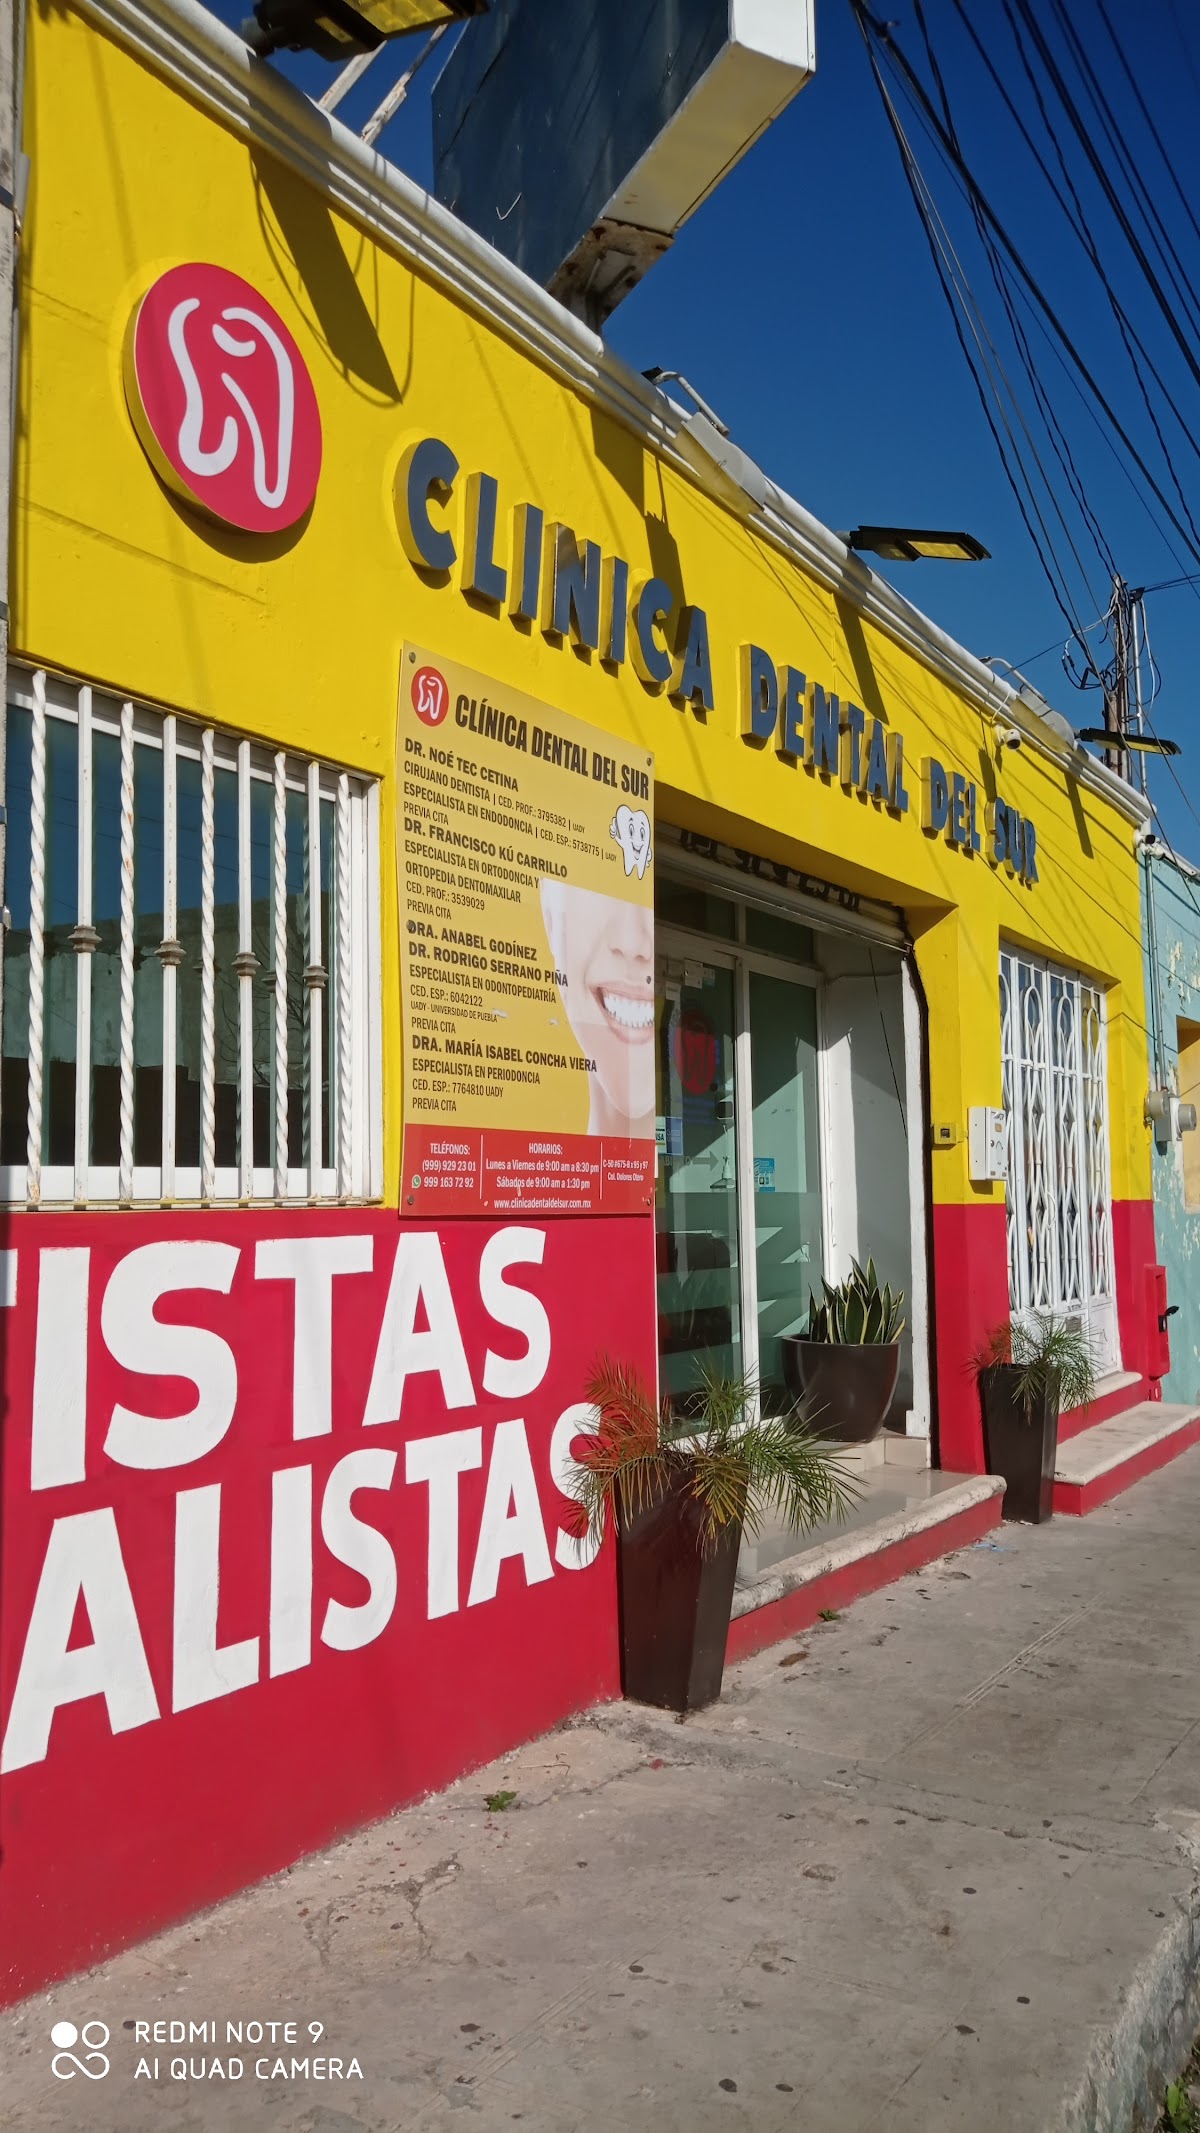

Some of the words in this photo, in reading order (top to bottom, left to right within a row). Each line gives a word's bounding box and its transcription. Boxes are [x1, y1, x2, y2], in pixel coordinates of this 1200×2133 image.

[404, 437, 715, 712] CLINICA
[746, 643, 909, 813] DENTAL
[926, 757, 980, 853] DEL
[989, 797, 1039, 884] SUR
[455, 694, 528, 753] CLÍNICA
[531, 726, 589, 778] DENTAL
[592, 751, 618, 788] DEL
[621, 764, 649, 801] SUR
[404, 737, 426, 758] DR.
[429, 746, 454, 769] NOÉ
[457, 757, 477, 777] TEC
[480, 766, 519, 792] CETINA
[404, 760, 449, 787] CIRUJANO
[450, 776, 491, 802] DENTISTA
[498, 795, 515, 811] CED.
[537, 808, 567, 828] 3795382
[572, 822, 586, 834] UADY
[403, 801, 431, 820] PREVIA
[432, 809, 449, 826] CITA
[404, 781, 466, 814] ESPECIALISTA
[467, 803, 479, 818] EN
[480, 807, 534, 836] ENDODONCIA
[540, 828, 555, 842] CED.
[572, 839, 600, 857] 5738775
[604, 852, 617, 862] UADY
[404, 816, 426, 836] DR.
[429, 824, 497, 857] FRANCISCO
[499, 846, 514, 863] KÚ
[516, 851, 568, 878] CARRILLO
[405, 839, 467, 869] ESPECIALISTA
[468, 858, 480, 873] EN
[481, 861, 534, 887] ORTODONCIA
[532, 877, 540, 889] Y
[405, 860, 456, 887] ORTOPEDIA
[457, 874, 521, 903] DENTOMAXILAR
[406, 880, 425, 896] CED.
[426, 885, 450, 902] PROF.:
[451, 892, 485, 911] 3539029
[407, 898, 434, 916] PREVIA
[435, 905, 452, 920] CITA
[441, 927, 487, 951] ANABEL
[489, 939, 538, 961] GODÍNEZ
[408, 941, 431, 959] DR.
[433, 946, 488, 971] RODRIGO
[490, 958, 542, 982] SERRANO
[544, 969, 569, 987] PIÑA
[409, 964, 471, 988] ESPECIALISTA
[472, 976, 483, 990] EN
[485, 978, 557, 1004] ODONTOPEDIATRÍA
[410, 984, 429, 998] CED.
[430, 987, 449, 1002] ESP.:
[450, 989, 483, 1007] 6042122
[410, 1000, 427, 1011] UADY
[430, 1003, 469, 1018] UNIVERSIDAD
[469, 1009, 477, 1019] DE
[477, 1010, 498, 1023] PUEBLA
[411, 1016, 438, 1032] PREVIA
[440, 1021, 457, 1034] CITA
[412, 1034, 442, 1053] DRA.
[445, 1039, 483, 1058] MARÍA
[485, 1044, 523, 1063] ISABEL
[525, 1050, 568, 1069] CONCHA
[569, 1056, 598, 1073] VIERA
[412, 1057, 473, 1077] ESPECIALISTA
[474, 1065, 486, 1079] EN
[487, 1066, 541, 1085] PERIODONCIA
[412, 1078, 431, 1091] CED.
[452, 1082, 485, 1096] 7764810
[485, 1085, 504, 1098] UADY
[412, 1097, 440, 1111] PREVIA
[440, 1099, 457, 1112] CITA
[430, 1140, 471, 1155] TELÉFONOS:
[528, 1142, 563, 1155] HORARIOS:
[422, 1159, 441, 1173] (999)
[442, 1160, 456, 1172] 929
[457, 1160, 467, 1172] 23
[467, 1161, 476, 1172] 01
[485, 1158, 506, 1170] Lunes
[506, 1161, 511, 1170] a
[512, 1159, 536, 1171] Viernes
[536, 1160, 544, 1171] de
[545, 1160, 560, 1171] 9:00
[560, 1163, 570, 1172] am
[570, 1163, 575, 1172] a
[575, 1161, 590, 1173] 8:30
[590, 1164, 599, 1175] pm
[642, 1161, 649, 1170] 97
[423, 1176, 438, 1188] 999
[440, 1176, 453, 1188] 163
[454, 1177, 464, 1188] 72
[464, 1177, 474, 1188] 92
[496, 1176, 525, 1188] Sábados
[525, 1177, 535, 1188] de
[534, 1177, 550, 1188] 9:00
[551, 1179, 561, 1188] am
[561, 1179, 566, 1188] a
[566, 1177, 581, 1189] 1:30
[580, 1179, 591, 1191] pm
